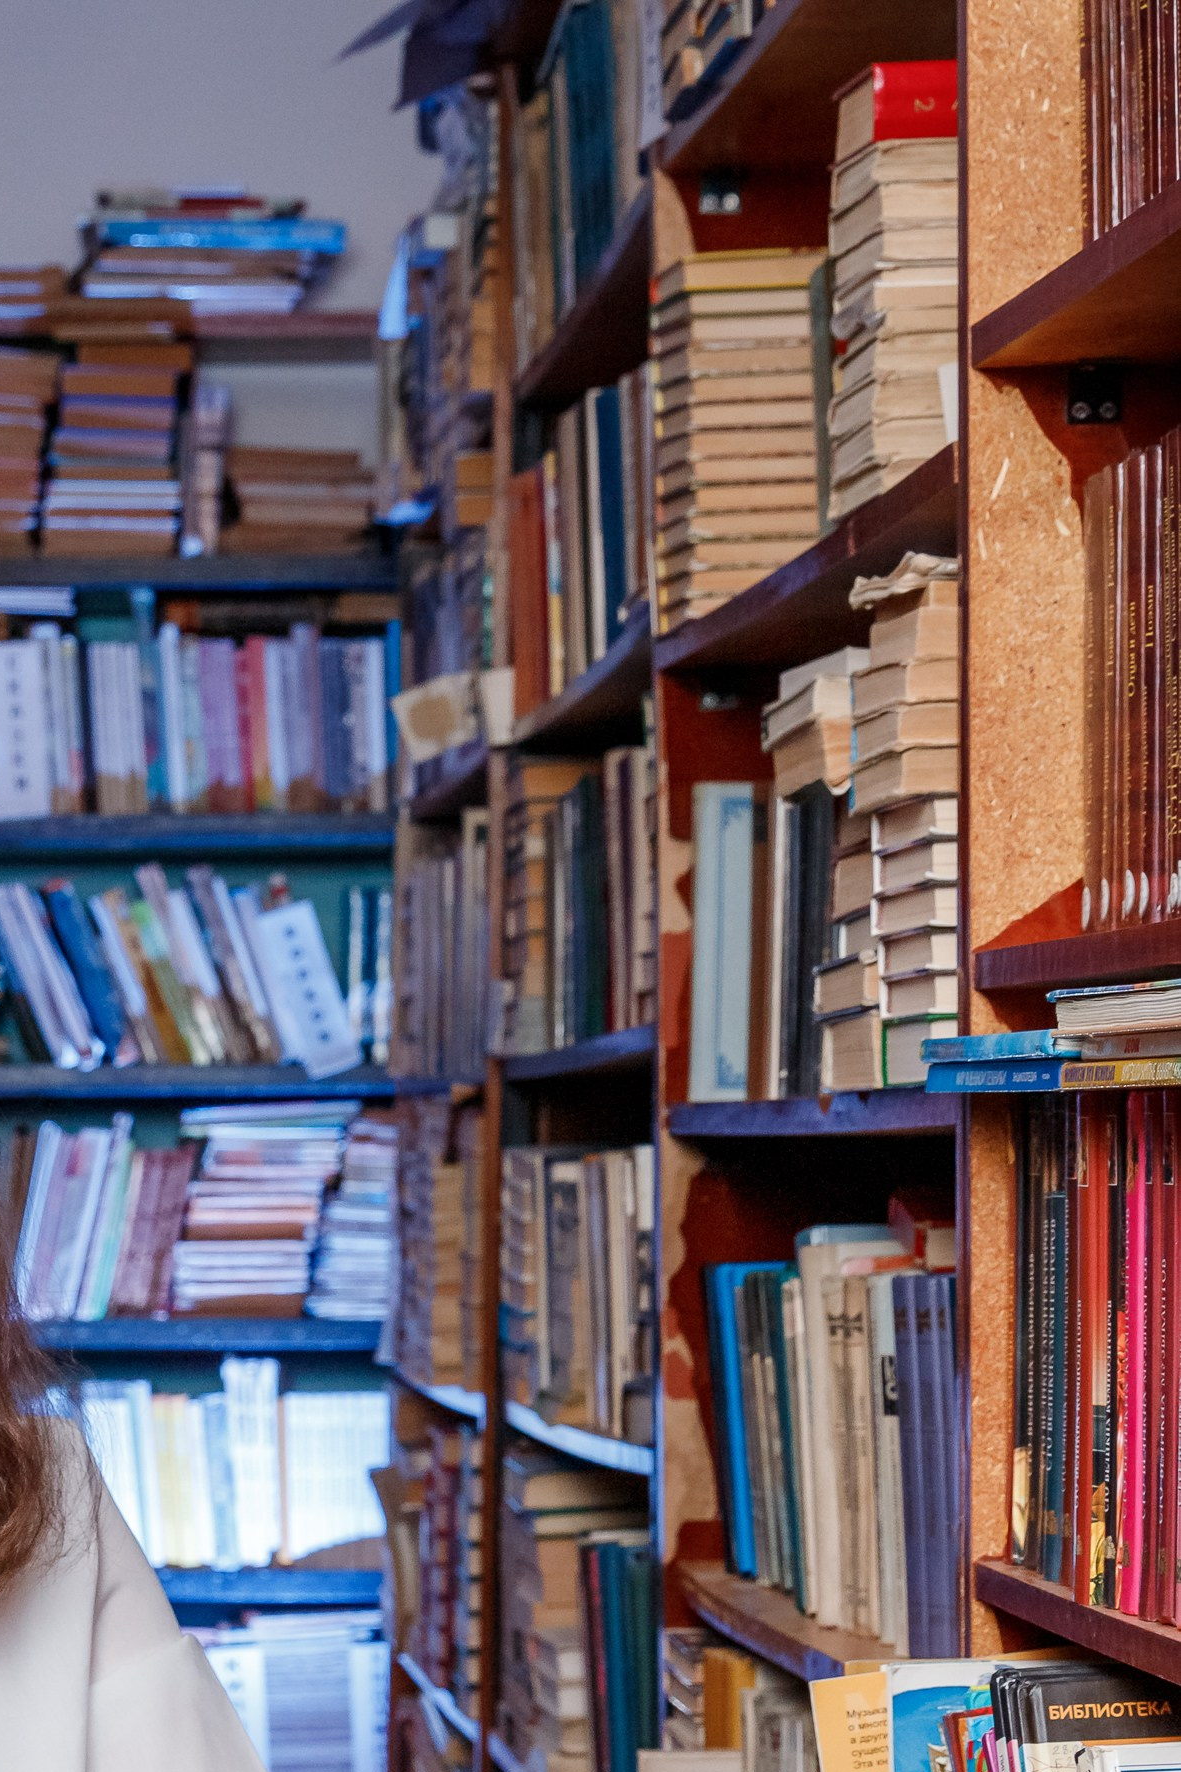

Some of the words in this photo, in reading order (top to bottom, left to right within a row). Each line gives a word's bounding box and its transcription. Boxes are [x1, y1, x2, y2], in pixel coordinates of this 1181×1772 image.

[1144, 585, 1154, 648] Поэмы
[1127, 652, 1138, 697] Отцы
[1048, 1700, 1171, 1721] БИБЛИОТЕКА
